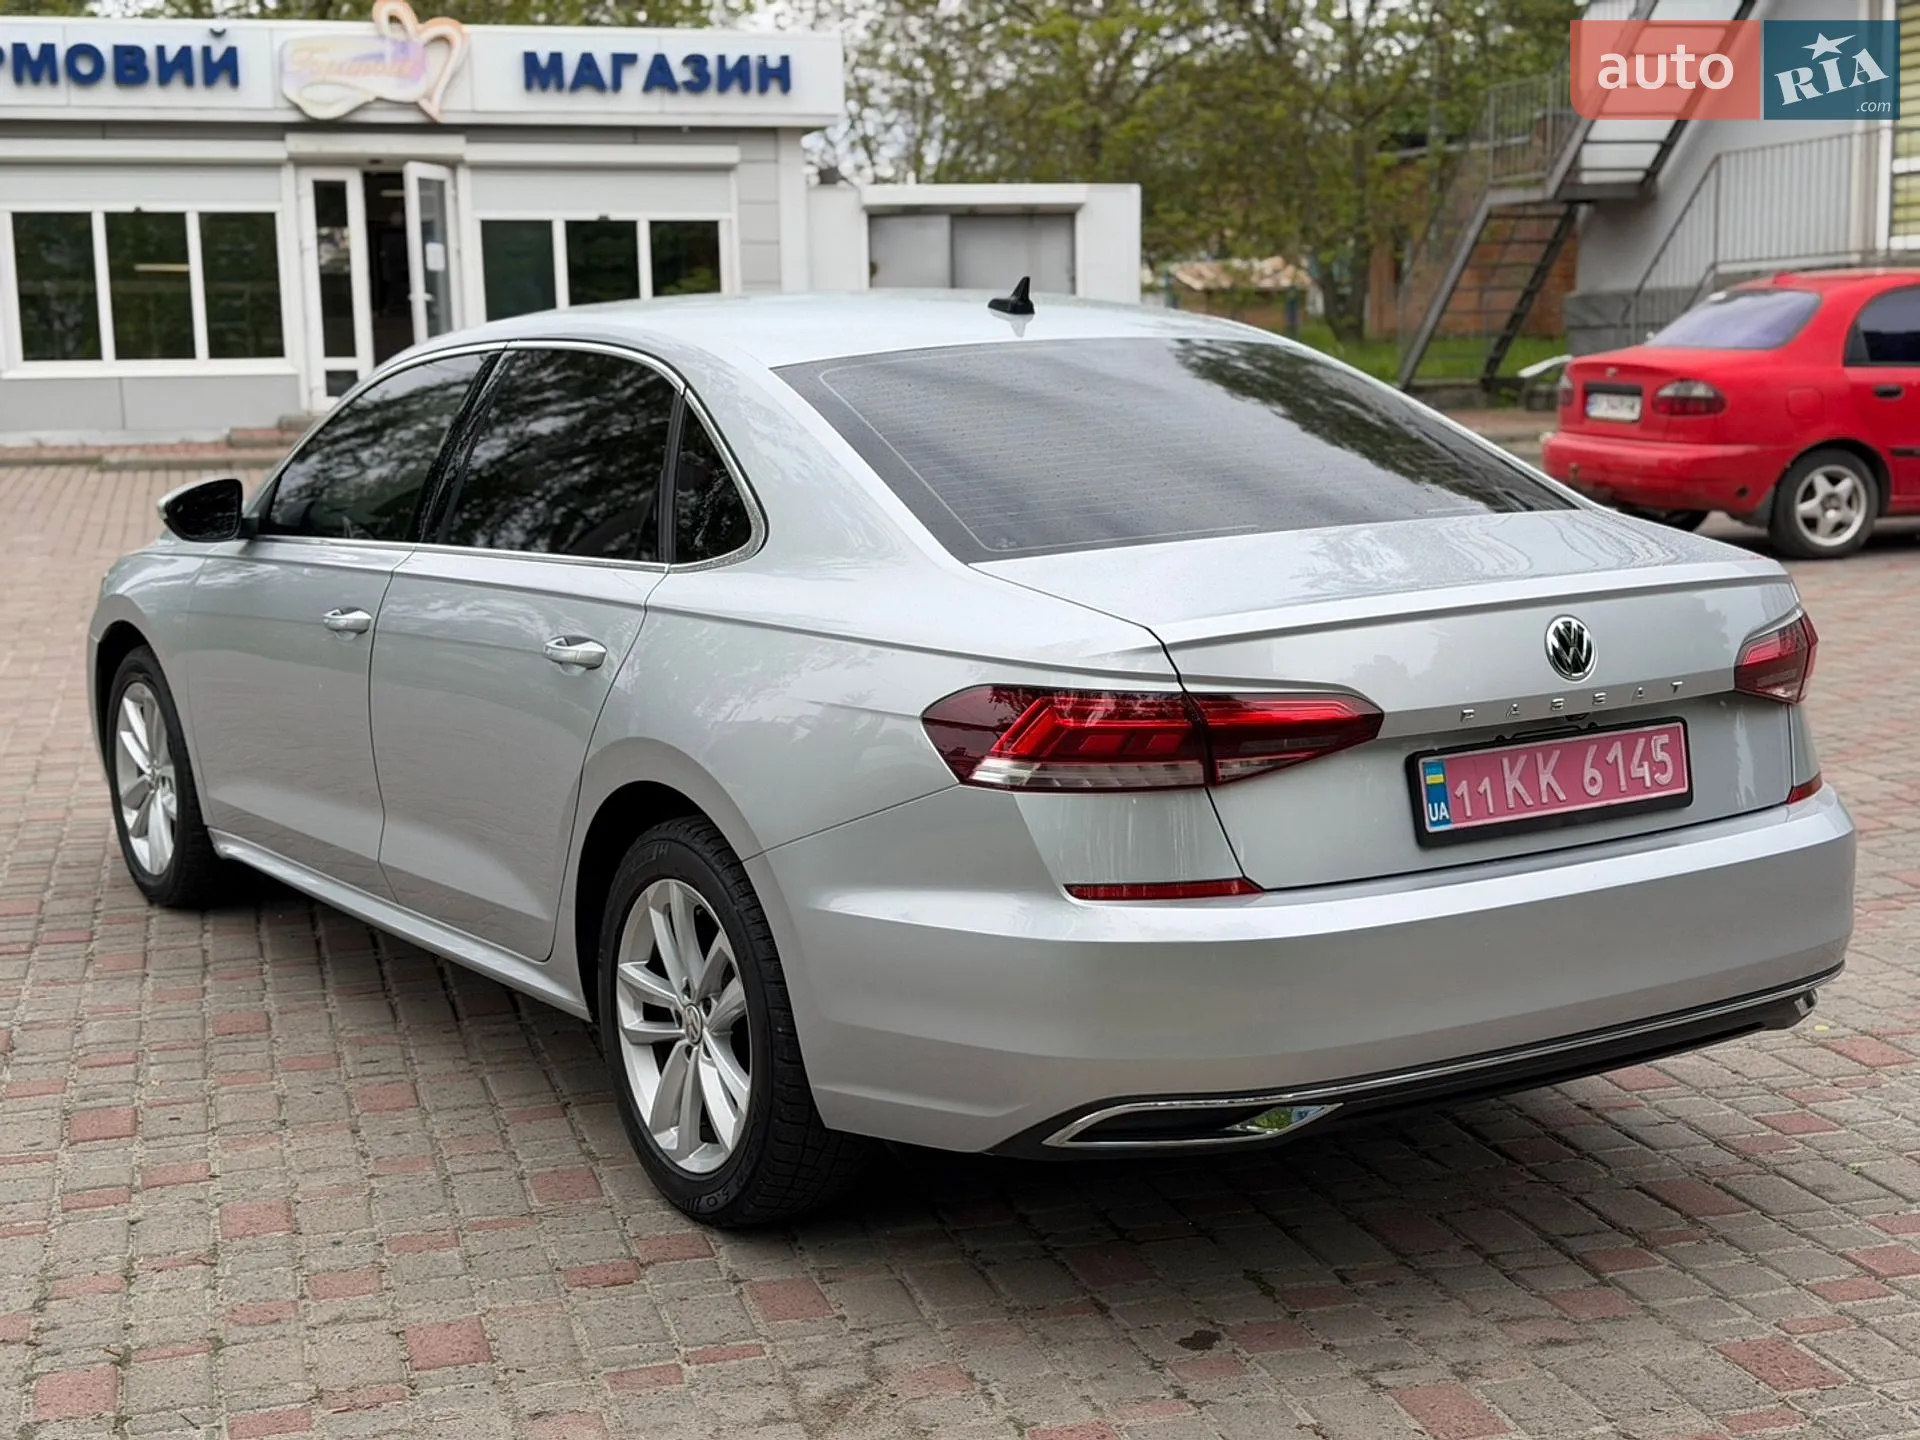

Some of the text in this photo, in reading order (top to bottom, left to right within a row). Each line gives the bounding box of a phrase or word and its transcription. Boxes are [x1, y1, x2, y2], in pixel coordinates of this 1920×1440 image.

[0, 28, 240, 88] МОВИЙ
[522, 51, 792, 95] МАГАЗИН
[1460, 680, 1684, 722] PASSAT
[1428, 801, 1450, 823] UA
[1582, 734, 1674, 797] 6145
